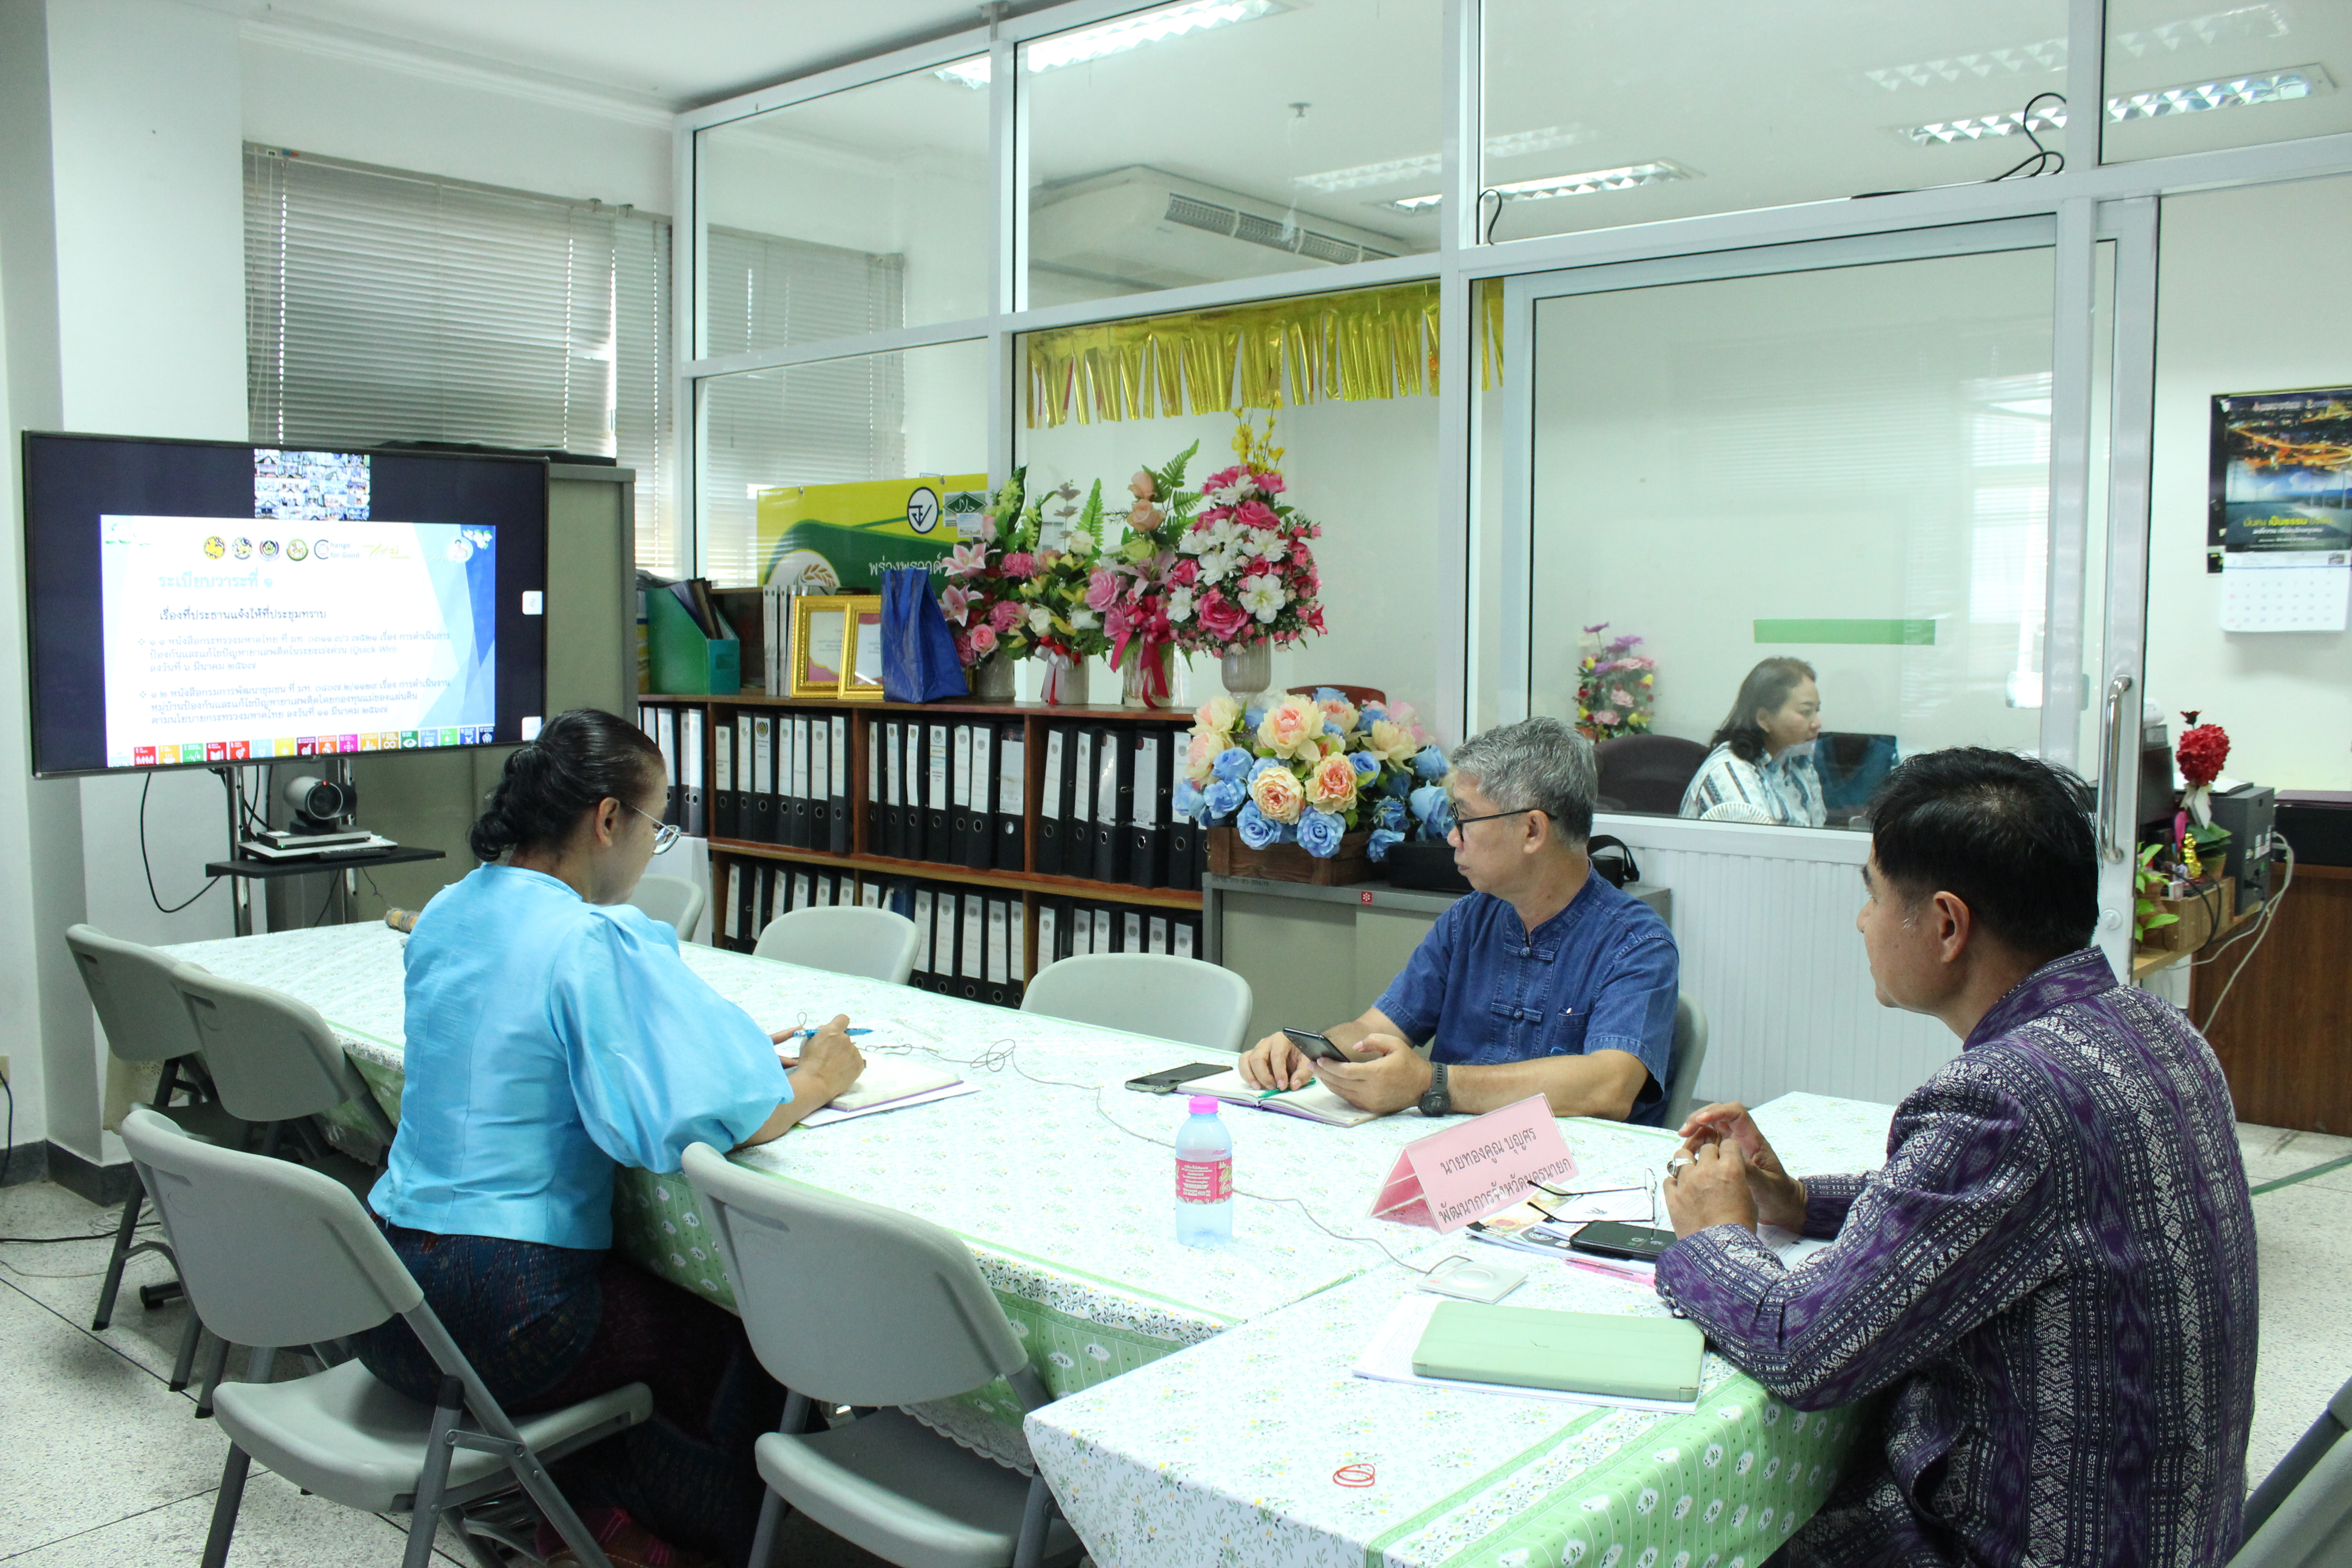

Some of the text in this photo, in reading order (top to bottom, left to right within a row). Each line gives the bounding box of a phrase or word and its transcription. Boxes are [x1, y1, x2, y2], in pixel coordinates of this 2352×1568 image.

[159, 567, 273, 588] ระเบียบวาระที่ ๑
[159, 605, 327, 622] เรื่องที่ประธานแจ้งให้ที่ประชุมทราบ
[168, 633, 278, 646] หนังสือกระทรวงมหาดไทย
[380, 629, 396, 641] เรื่อง
[399, 630, 450, 641] การดำเนินการ
[149, 645, 397, 660] ป้องกันและแก้ไขปัญหายาเสพติดในระยะเร่งด่วน (Quick Win)
[150, 658, 181, 672] ลงวันที่
[193, 661, 225, 671] มีนาคม
[228, 661, 256, 670] ๒๕๖๗
[170, 686, 286, 698] หนังสือกรมการพัฒนาชุมชน
[380, 676, 397, 689] เรื่อง
[399, 678, 451, 689] การดำเนินงาน
[151, 690, 418, 715] หมู่บ้านป้องกันและแก้ไขปัญหายาเสพติดโดยกองทุนแม่ของแผ่นดิน
[151, 708, 284, 725] ตามนโยบายกระทรวงมหาดไทย
[286, 704, 314, 718] ลงวันที่
[331, 705, 359, 716] มีนาคม
[362, 705, 388, 714] ๒๕๖๗
[1440, 1127, 1537, 1175] นายทองคูณ บุญศร
[1439, 1158, 1572, 1224] พัฒนาการจังหวัดนครนายก
